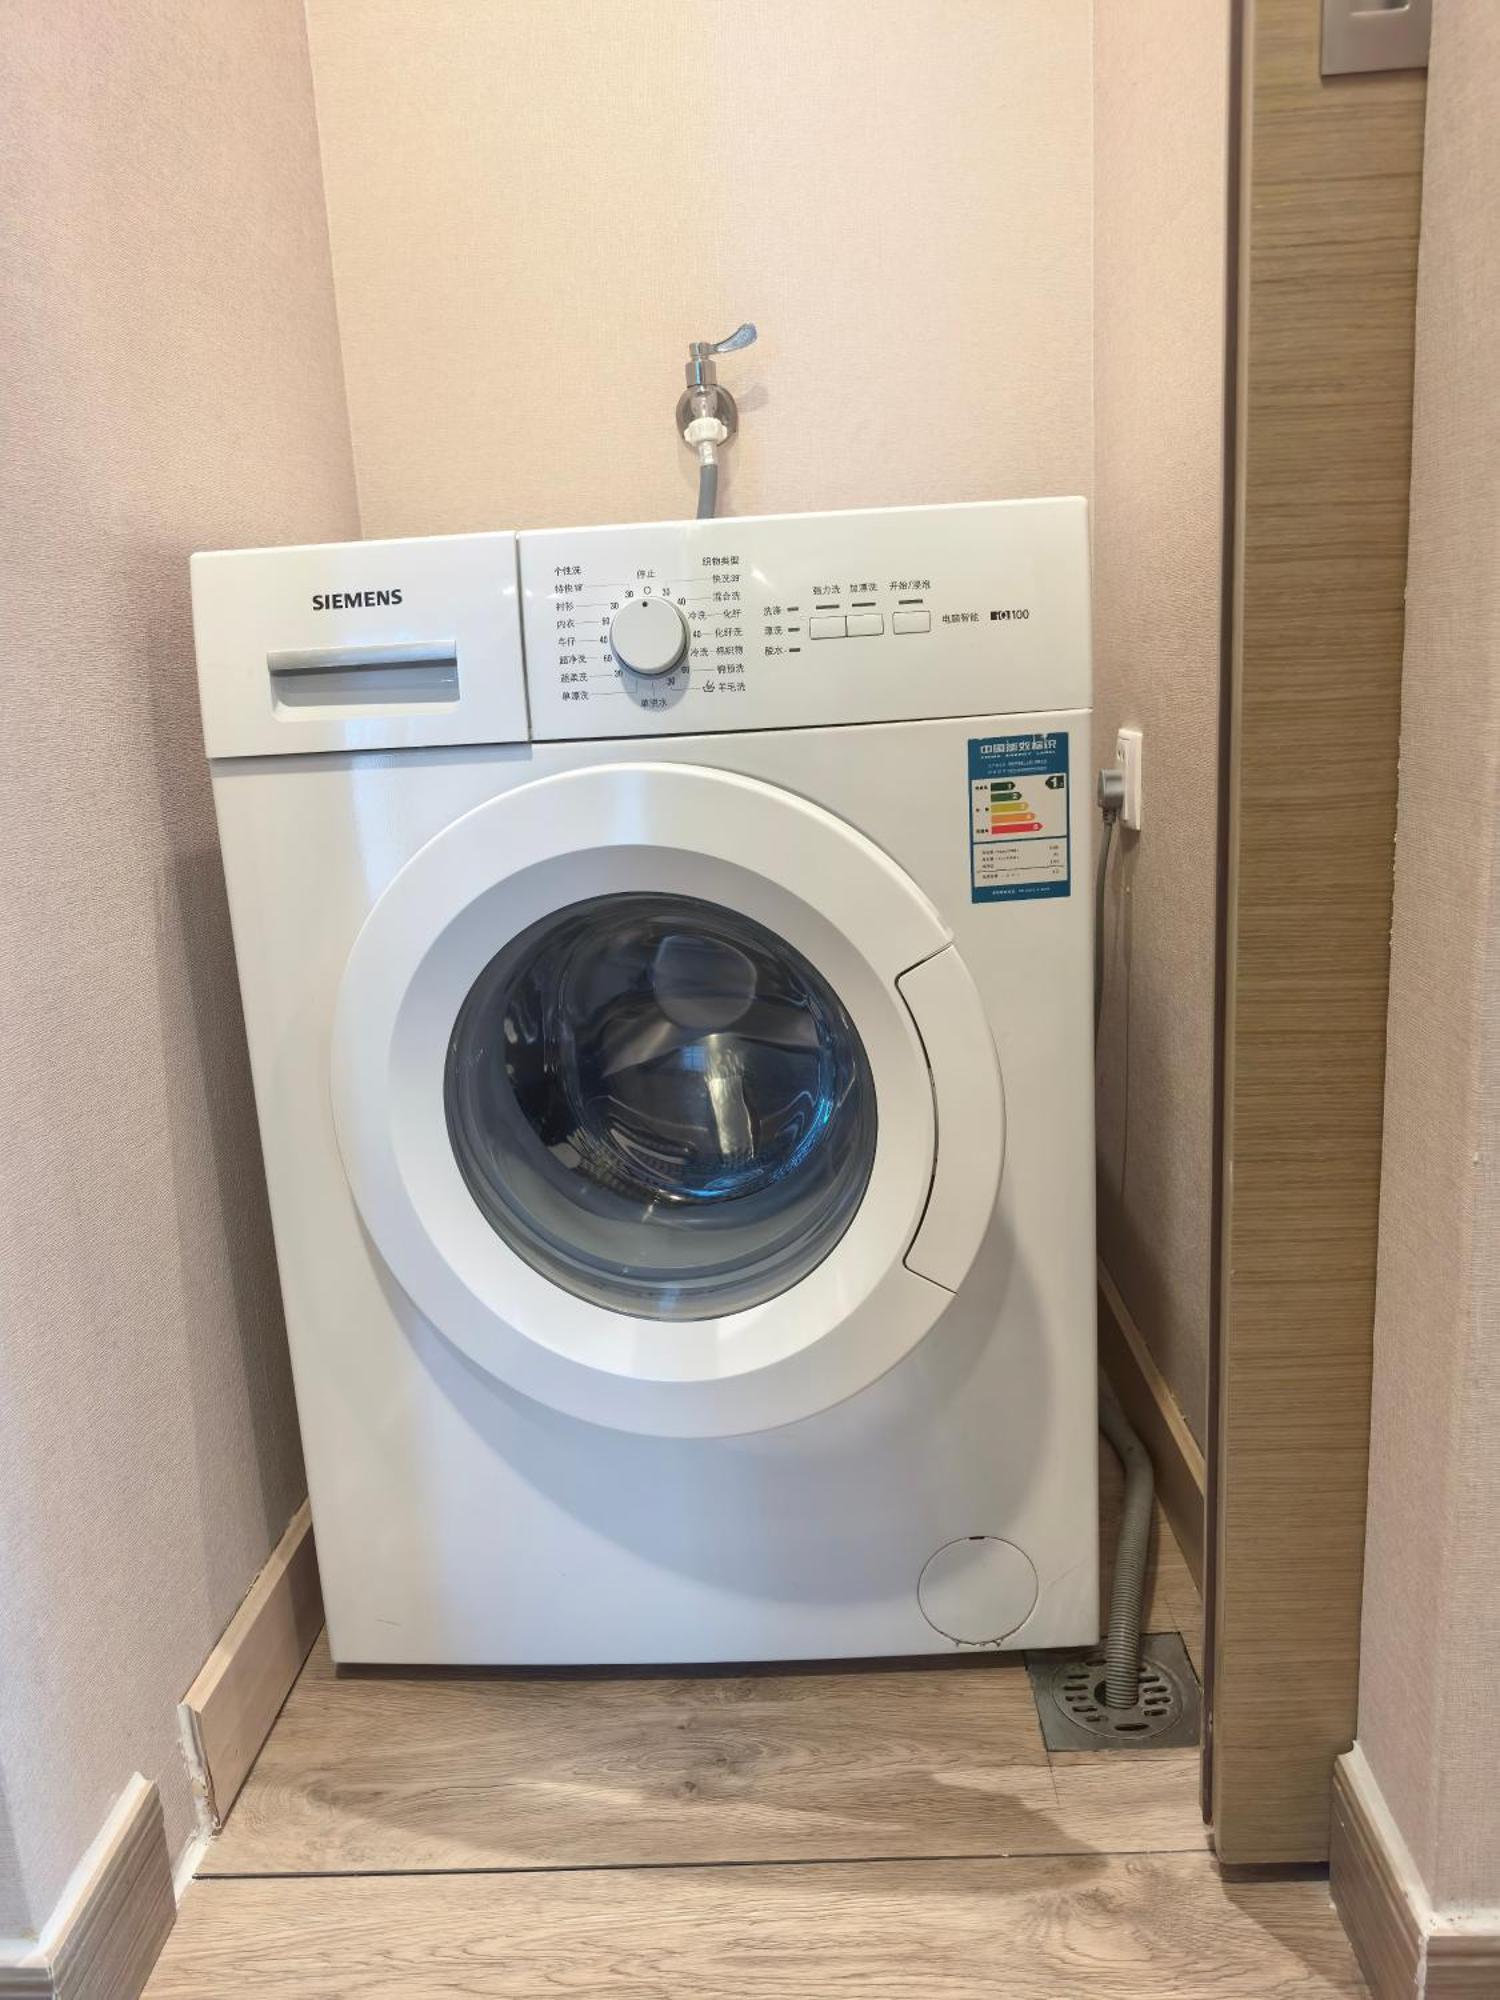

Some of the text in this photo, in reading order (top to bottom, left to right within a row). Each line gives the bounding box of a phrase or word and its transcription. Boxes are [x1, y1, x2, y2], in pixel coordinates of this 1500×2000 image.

[554, 565, 582, 576] 个性洗
[636, 569, 656, 580] 停止
[812, 584, 841, 595] 强力洗
[312, 589, 403, 611] SIEMENS
[556, 619, 575, 630] 内衣
[558, 636, 576, 647] 牛仔
[718, 681, 746, 692] 羊毛洗
[980, 739, 1057, 754] 中国能效标识
